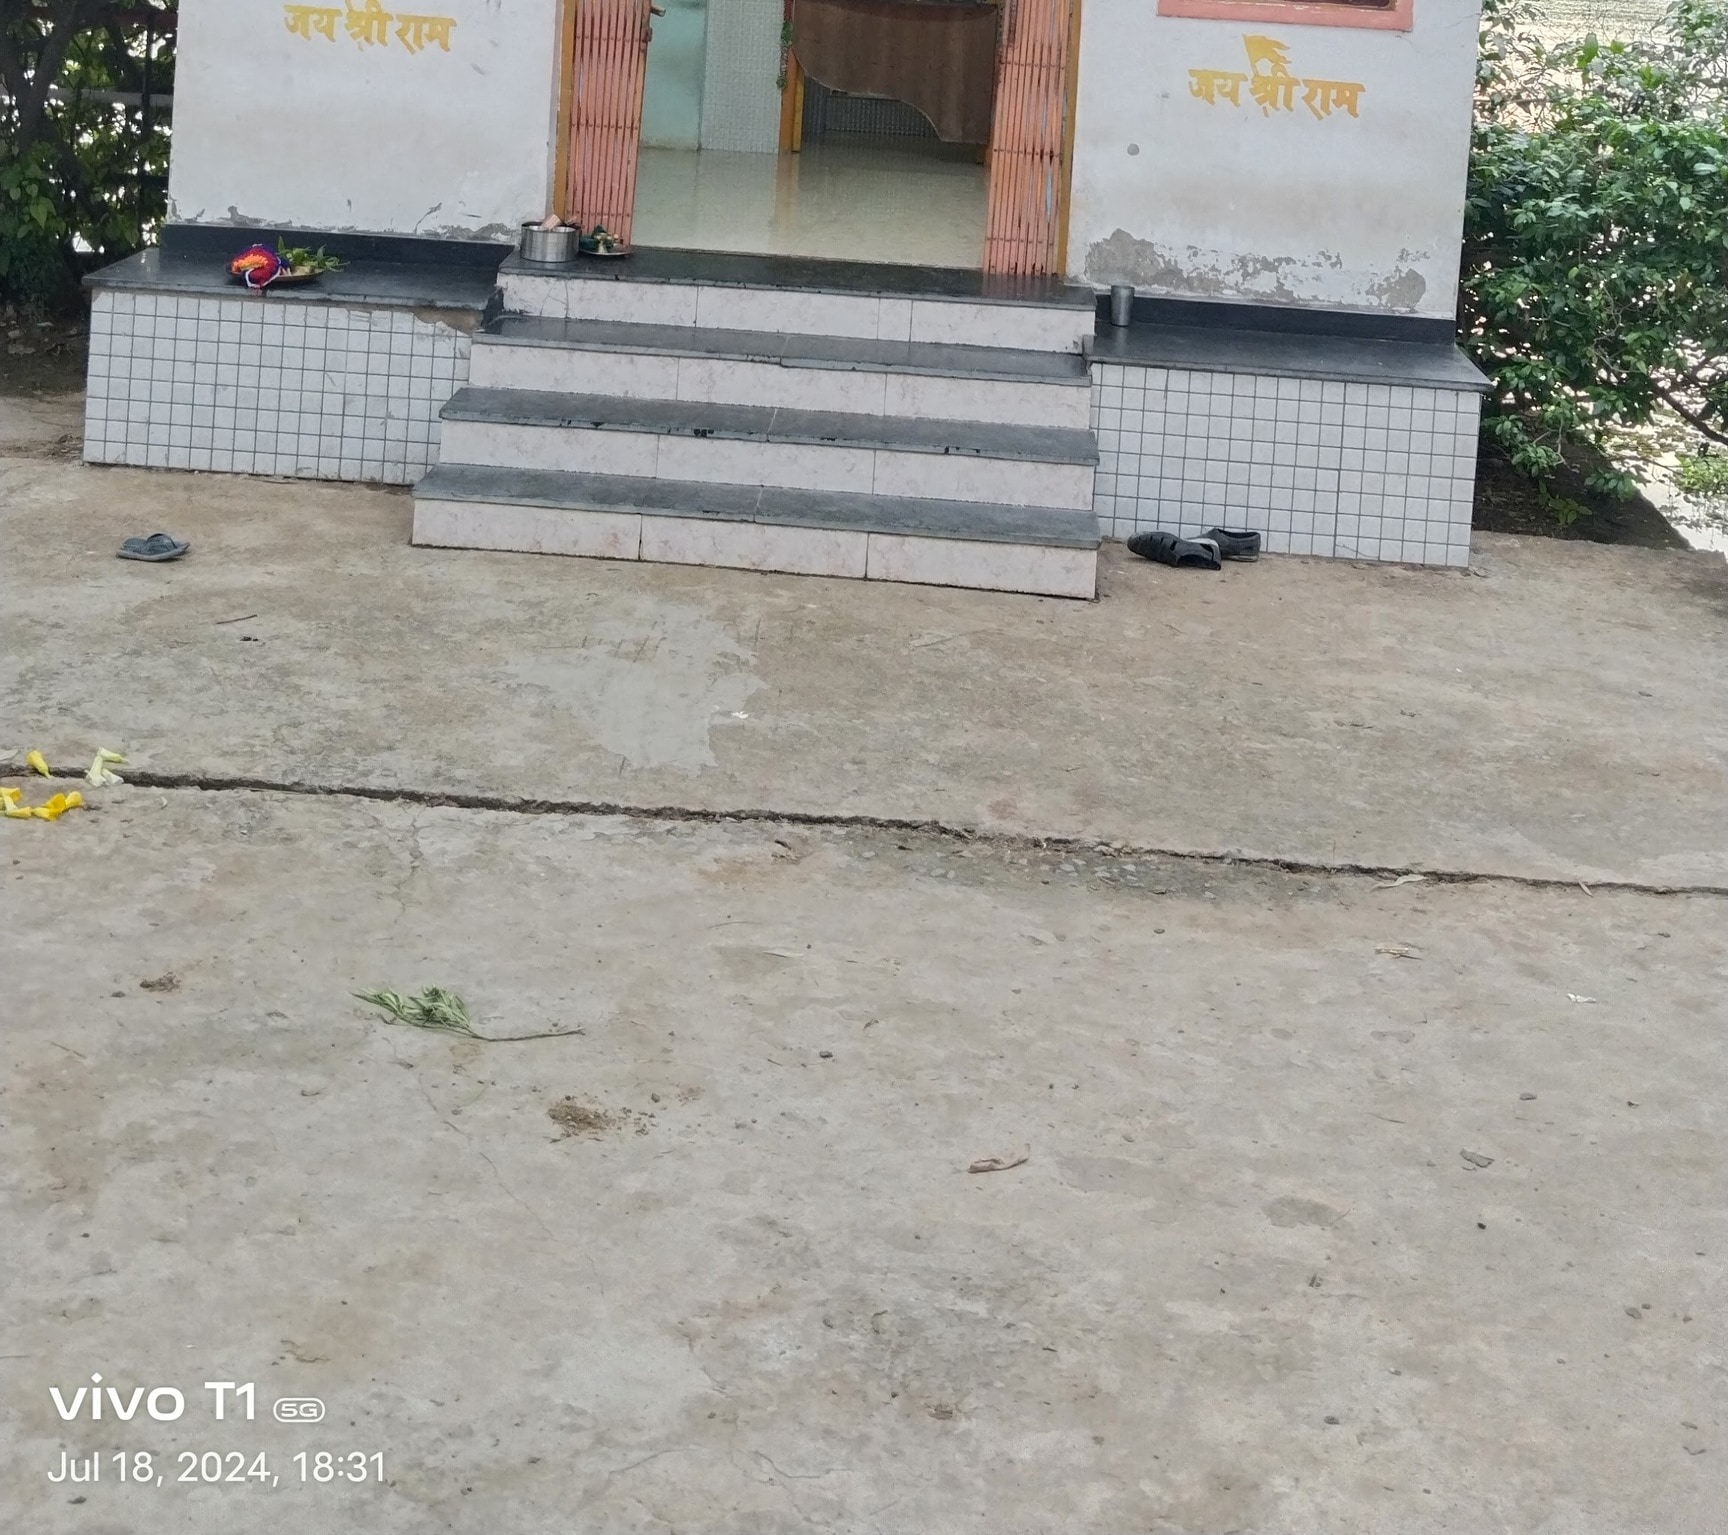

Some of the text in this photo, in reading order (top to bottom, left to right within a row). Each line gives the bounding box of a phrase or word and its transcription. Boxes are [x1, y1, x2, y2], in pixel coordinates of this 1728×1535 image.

[284, 4, 342, 43] जय
[395, 14, 457, 55] राम
[1188, 63, 1366, 121] जय श्री राम
